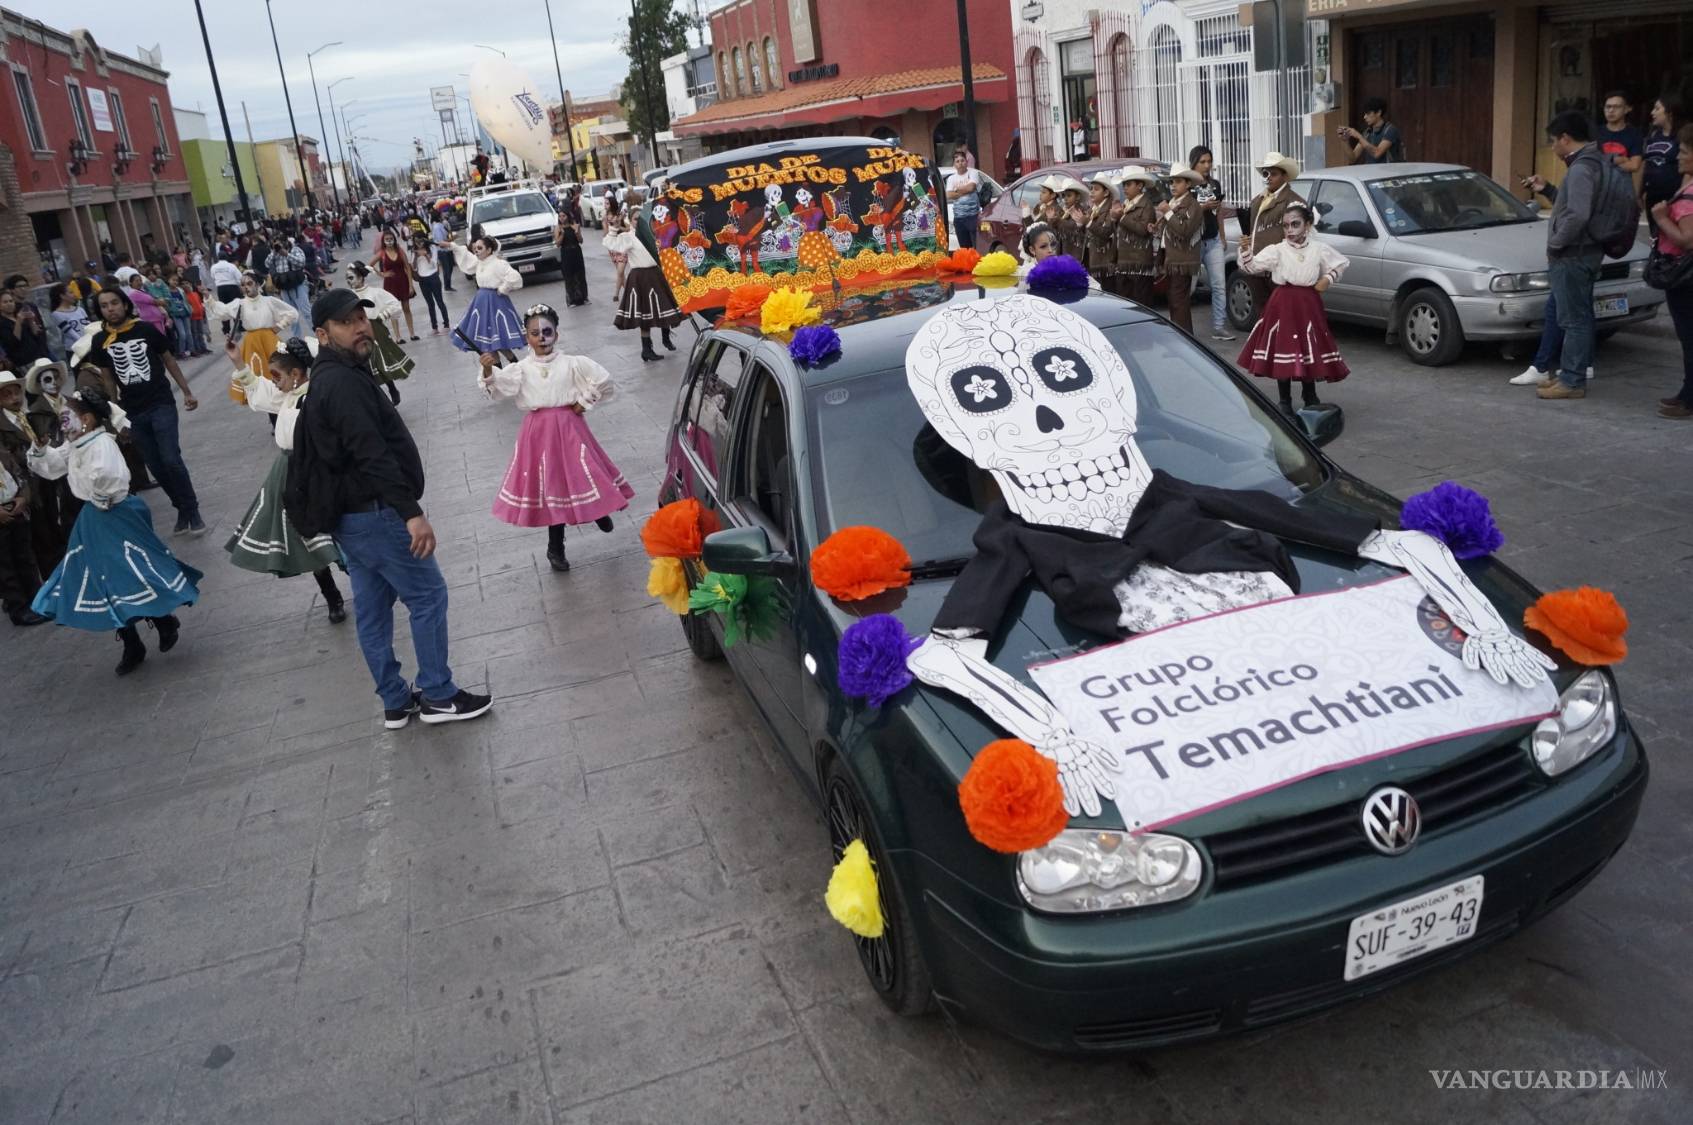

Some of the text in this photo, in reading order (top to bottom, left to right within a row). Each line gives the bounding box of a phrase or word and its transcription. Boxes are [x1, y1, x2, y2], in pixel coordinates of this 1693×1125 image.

[708, 165, 847, 201] MUERTOS
[726, 163, 777, 179] DIA
[1080, 655, 1214, 700] Grupo
[1099, 663, 1319, 733] Folclórico
[1125, 664, 1464, 780] Temachtiani
[1353, 898, 1477, 961] SUF-39-43
